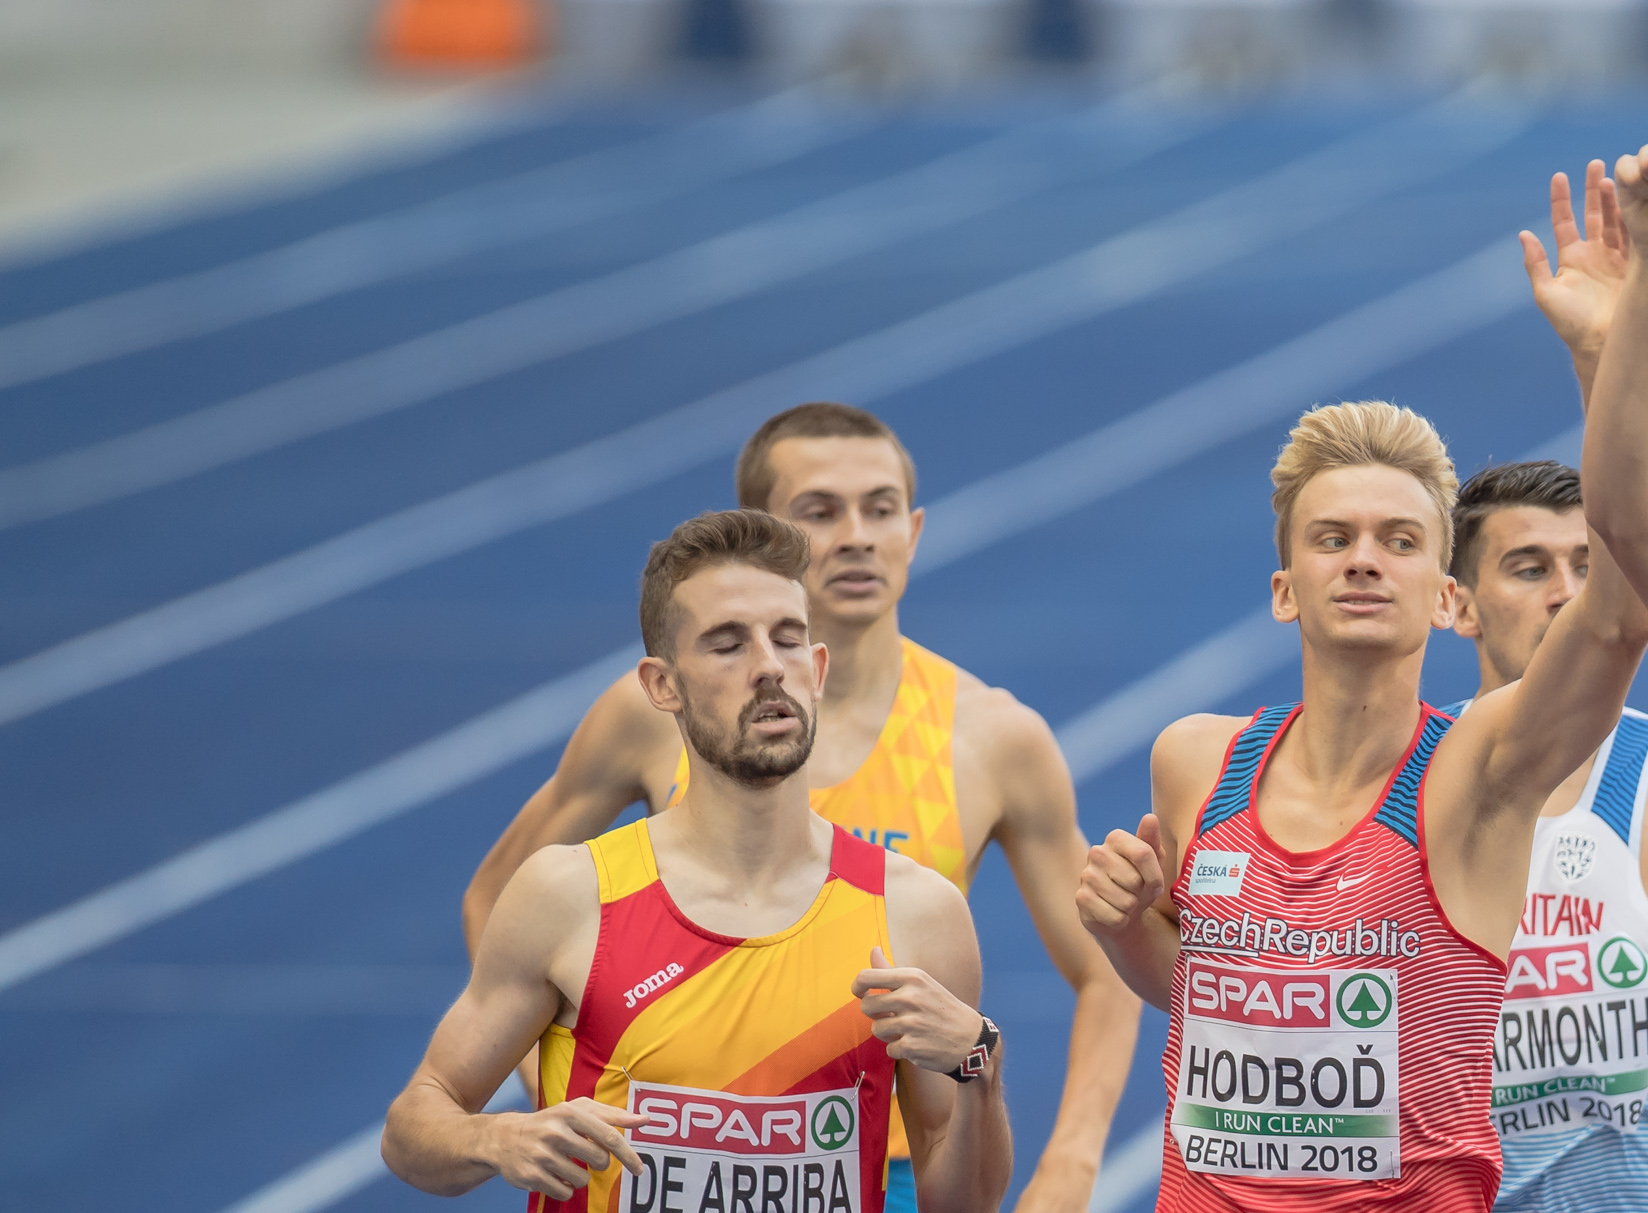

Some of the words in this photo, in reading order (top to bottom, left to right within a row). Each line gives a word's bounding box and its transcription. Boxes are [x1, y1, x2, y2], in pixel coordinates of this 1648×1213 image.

[1197, 863, 1228, 877] ČESKÁ
[1180, 908, 1421, 963] CzechRepublic
[1520, 893, 1604, 937] ITAIN
[1504, 952, 1589, 994] AR
[1190, 974, 1326, 1020] SPAR
[1186, 1044, 1385, 1109] HODBOĎ
[1495, 1085, 1539, 1104] RUN
[637, 1098, 802, 1147] SPAR
[1215, 1111, 1220, 1129] I
[1223, 1113, 1261, 1132] RUN
[1495, 1097, 1571, 1136] RLIN
[1580, 1096, 1643, 1128] 2018
[1185, 1135, 1290, 1172] BERLIN
[1301, 1144, 1378, 1173] 2018
